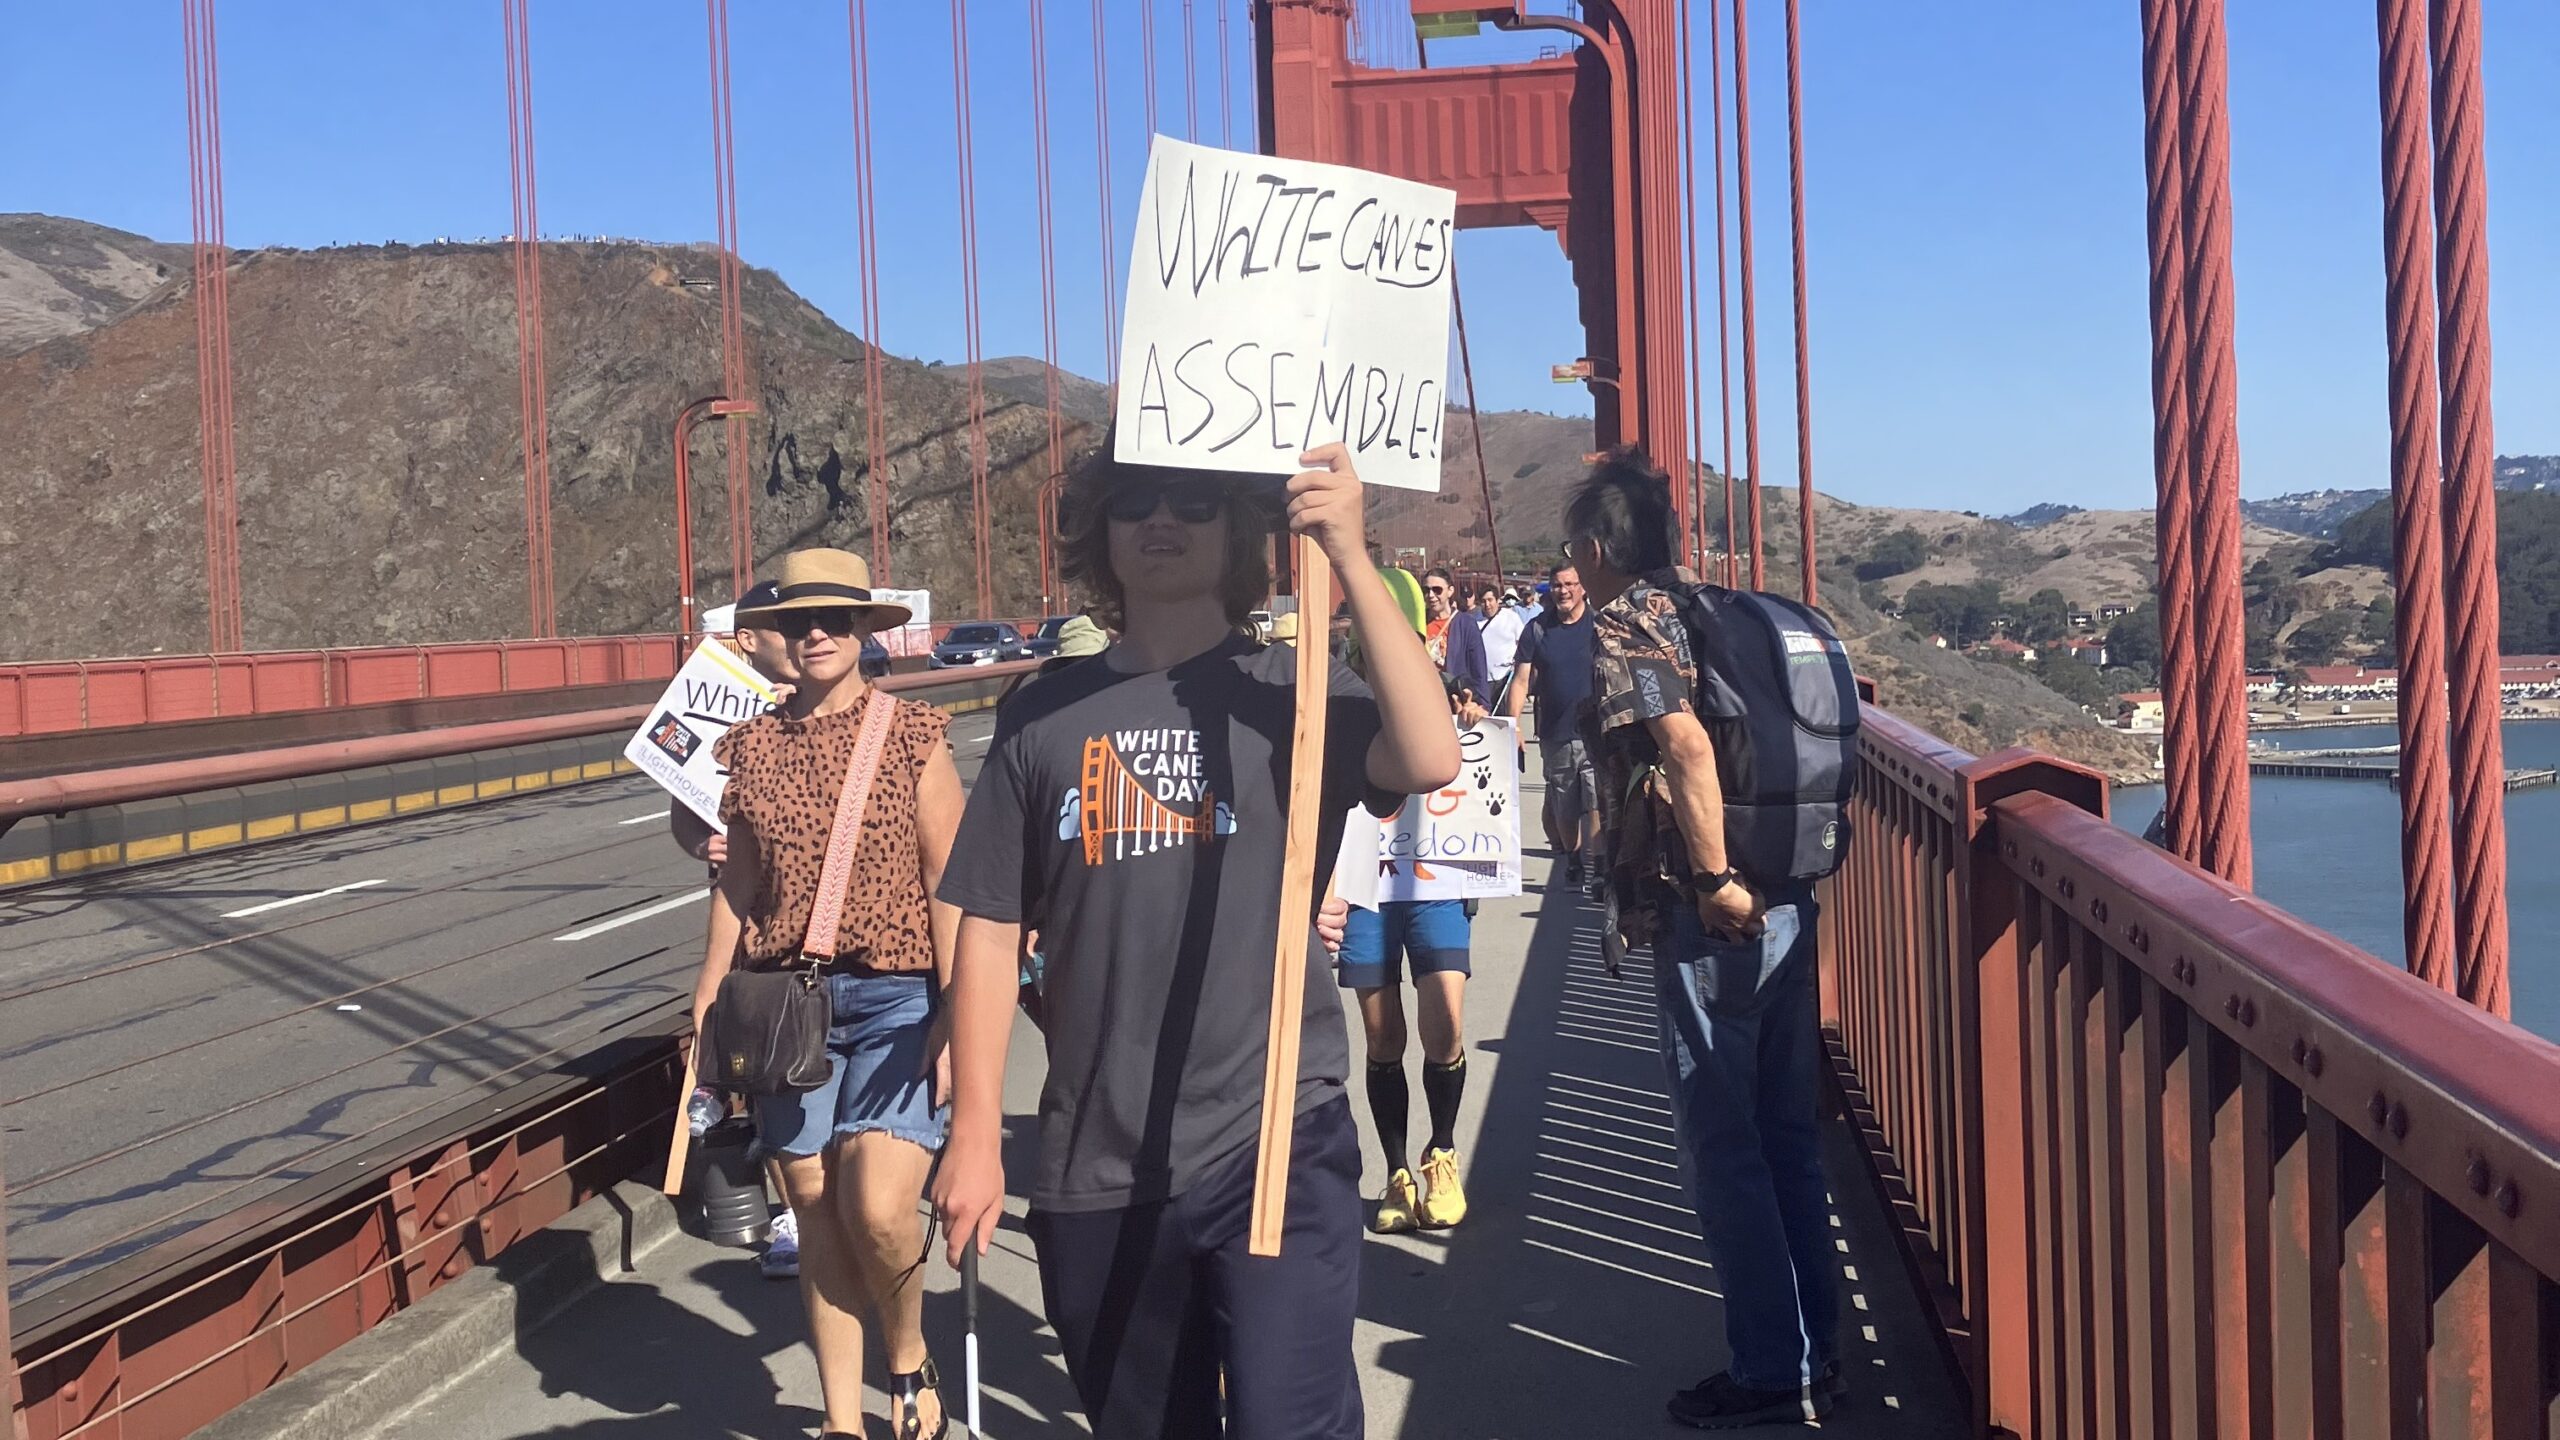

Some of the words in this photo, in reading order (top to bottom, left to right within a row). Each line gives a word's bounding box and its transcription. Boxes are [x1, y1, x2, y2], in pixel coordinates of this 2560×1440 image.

[1340, 197, 1451, 288] CANES
[1138, 339, 1442, 459] ASSEMBLE!
[1115, 728, 1200, 752] WHITE
[641, 747, 711, 806] LIGHTHOUSE
[1133, 753, 1203, 777] CANE
[1157, 777, 1208, 802] DAY
